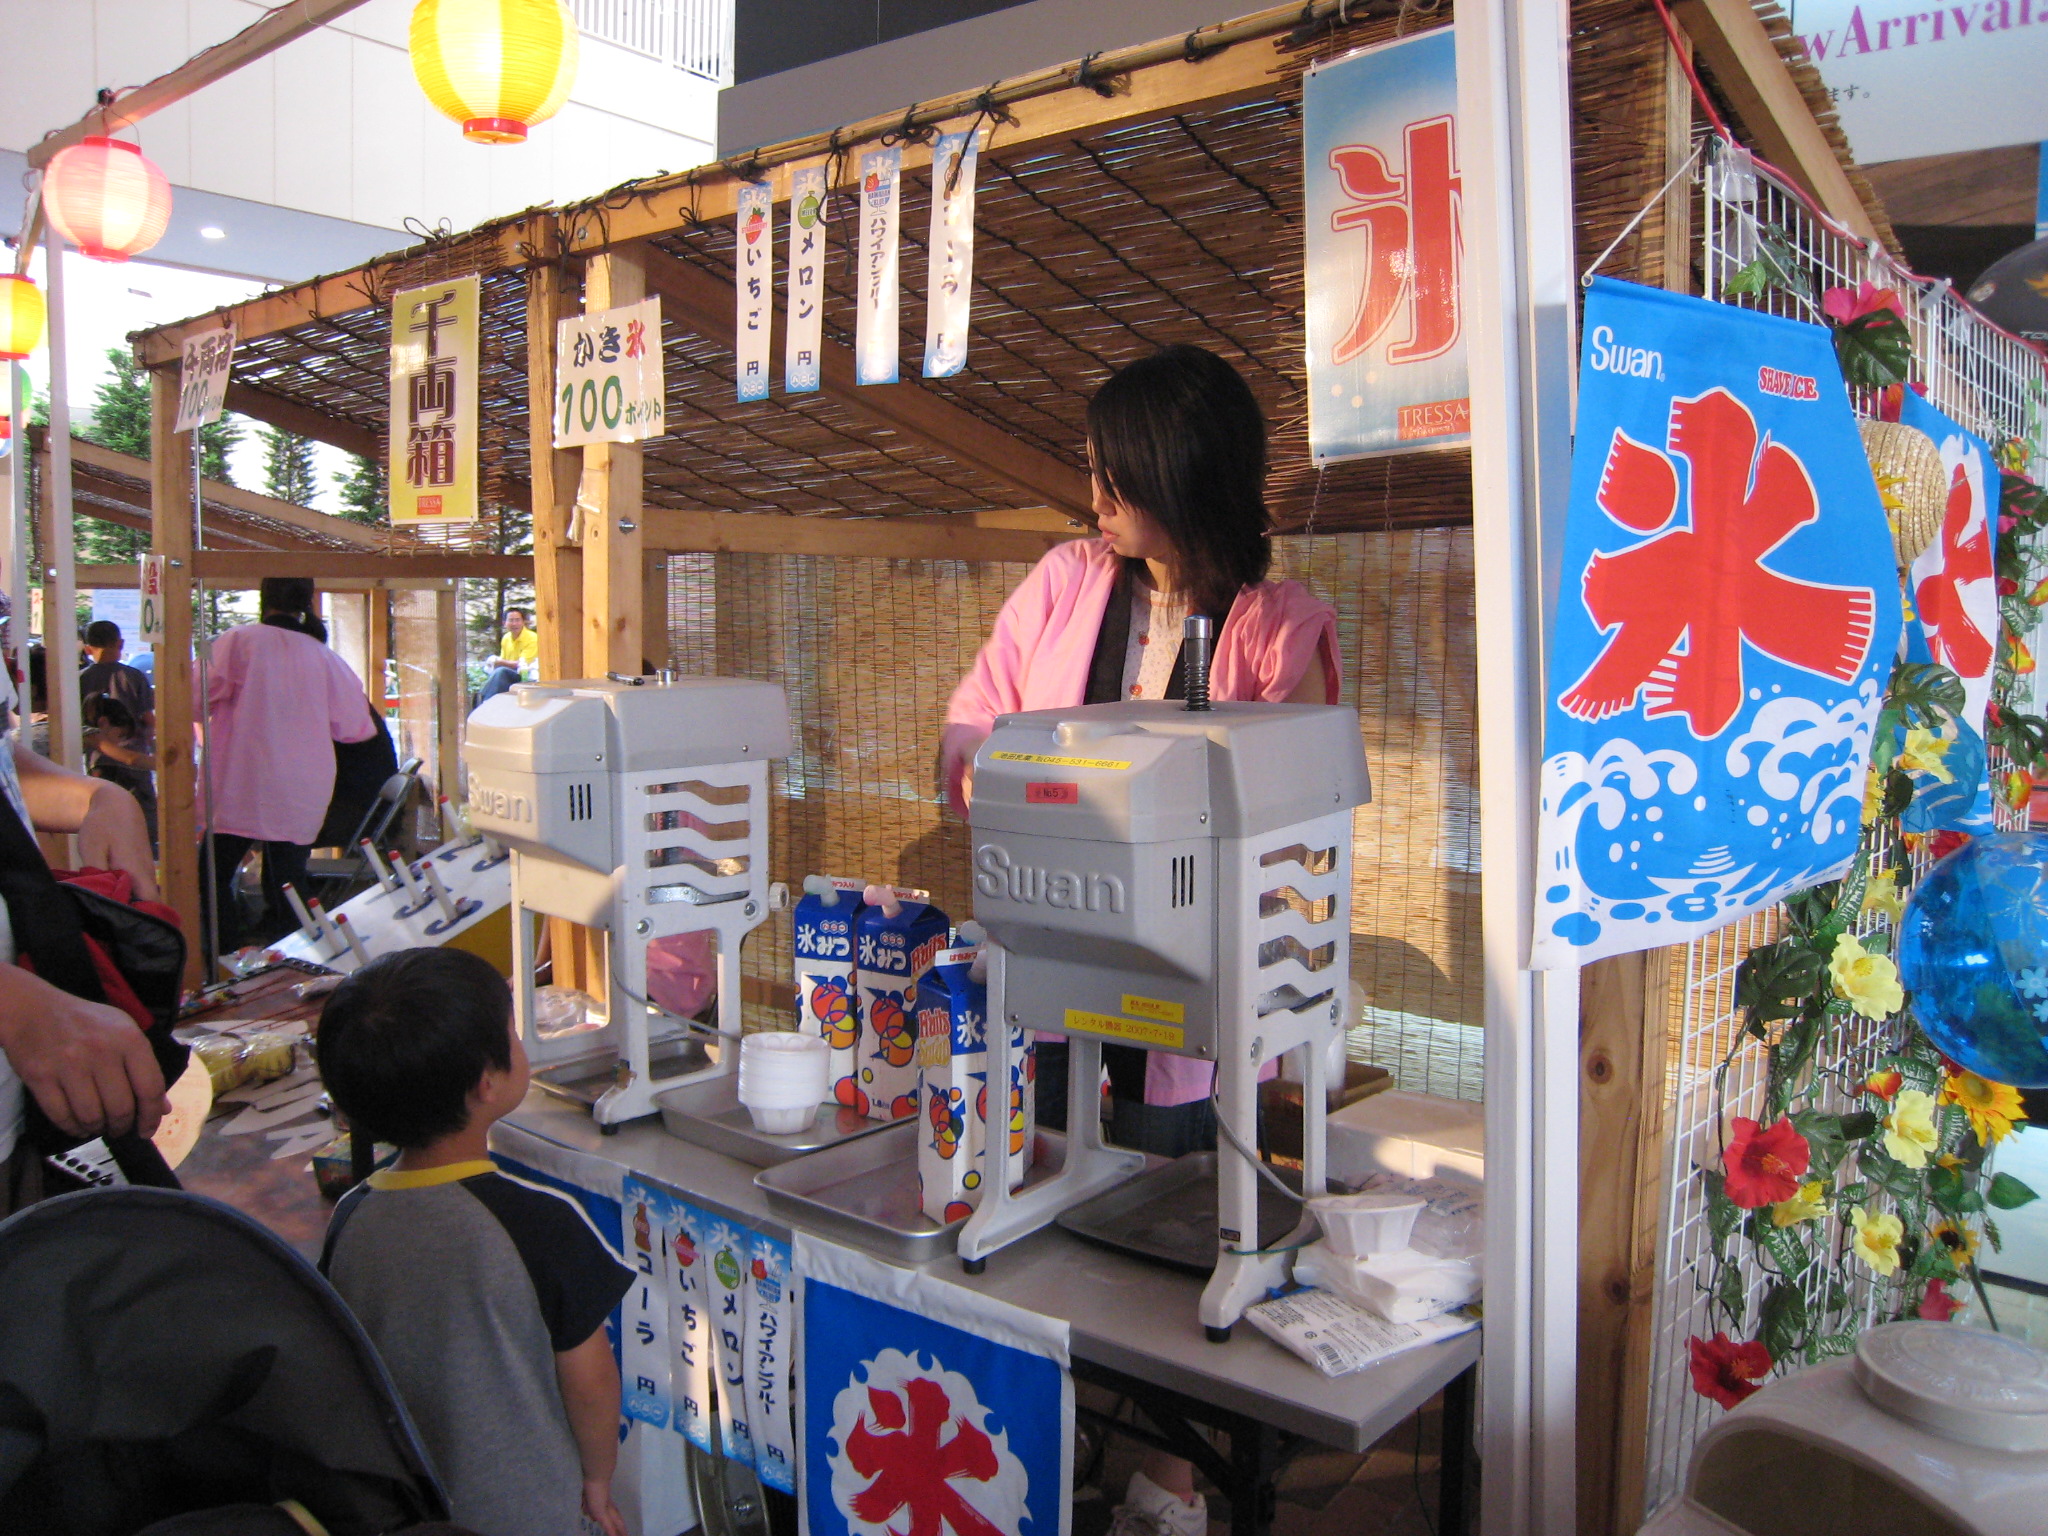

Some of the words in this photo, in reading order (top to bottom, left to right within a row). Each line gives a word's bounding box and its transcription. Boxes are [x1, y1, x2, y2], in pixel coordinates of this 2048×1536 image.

[747, 248, 762, 331] いちご
[799, 231, 814, 319] メロン
[573, 319, 646, 368] かき氷
[747, 360, 759, 376] 円
[798, 350, 812, 366] 円
[1591, 325, 1662, 380] Swan
[406, 289, 459, 489] 千両箱
[561, 375, 623, 435] 100
[1758, 366, 1793, 398] SHAVE
[1792, 374, 1819, 400] ICE
[1399, 403, 1468, 428] TRESSA
[1558, 387, 1874, 739] 氷
[467, 772, 532, 823] Swan
[976, 844, 1125, 914] Swan
[797, 924, 850, 957] 氷みつ
[859, 934, 907, 971] 氷みつ
[636, 1252, 655, 1346] コーラ
[680, 1269, 697, 1367] いちご
[722, 1294, 744, 1386] メロン
[637, 1376, 655, 1396] 円
[684, 1395, 698, 1417] 円
[732, 1418, 749, 1439] 円
[766, 1443, 785, 1465] 円
[845, 1376, 1006, 1536] 氷
